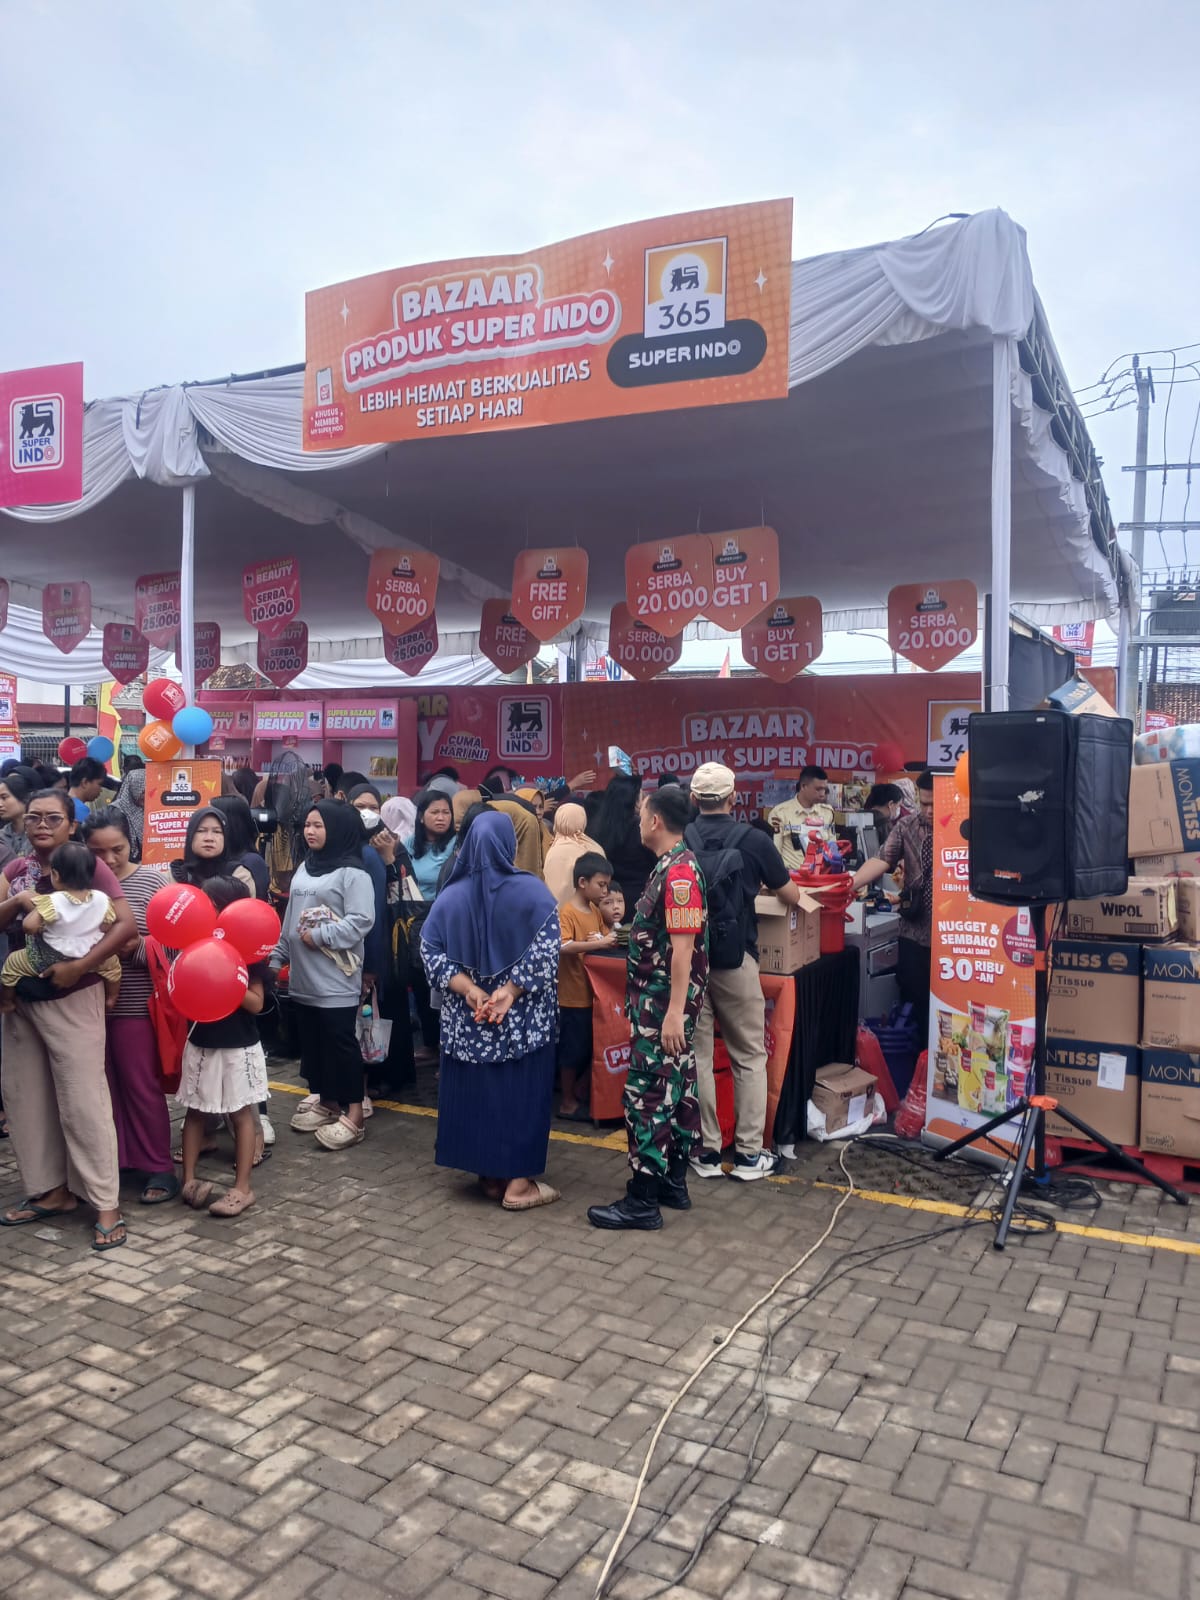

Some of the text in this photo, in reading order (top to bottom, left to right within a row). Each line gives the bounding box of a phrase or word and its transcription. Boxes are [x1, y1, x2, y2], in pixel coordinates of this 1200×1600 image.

[402, 272, 534, 322] BAZAAR
[658, 300, 710, 330] 365
[350, 299, 610, 375] PRODUK SUPER INDO
[628, 339, 742, 369] SUPER INDO
[359, 360, 591, 413] LEBIH HEMAT BERKUALITAS
[416, 397, 524, 428] SETIAP HARI
[314, 417, 339, 428] MEMBER
[22, 437, 51, 448] SUPER
[19, 445, 55, 464] INDO
[256, 566, 293, 584] BEAUTY
[648, 572, 693, 591] SERBA
[716, 566, 748, 583] BUY
[385, 579, 420, 595] SERBA
[529, 582, 568, 602] FREE
[713, 581, 768, 607] GET 1
[257, 588, 286, 604] SERBA
[637, 587, 708, 615] 20.000
[148, 601, 174, 615] SERBA
[252, 599, 294, 623] 10.000
[375, 593, 428, 616] 10.000
[531, 605, 562, 621] GIFT
[910, 613, 957, 629] SERBA
[142, 612, 180, 632] 25.000
[397, 632, 425, 647] SERBA
[495, 625, 526, 642] FREE
[627, 631, 666, 644] SERBA
[767, 629, 796, 643] BUY
[898, 628, 973, 651] 20.000
[270, 647, 296, 657] SERBA
[392, 641, 433, 661] 25.000
[496, 644, 521, 657] GIFT
[618, 643, 675, 663] 10.000
[751, 642, 814, 662] 1 GET 1
[263, 658, 301, 671] 10.000
[256, 718, 305, 731] BEAUTY
[325, 716, 376, 730] BEAUTY
[690, 714, 805, 742] BAZAAR
[448, 735, 482, 748] CUMA
[510, 732, 539, 740] SUPER
[440, 746, 466, 757] HARI
[506, 739, 543, 753] INDO
[637, 747, 874, 776] PRODUK SUPER INDO
[174, 783, 189, 792] 365
[1175, 767, 1200, 841] MONTISS
[150, 811, 179, 821] BAZAAR
[159, 820, 182, 830] SUPER
[941, 883, 962, 892] LEBIH
[1100, 902, 1143, 918] WIPOL
[938, 921, 1000, 936] NUGGET &
[1073, 915, 1079, 927] 8
[941, 934, 998, 949] SEMBAKO
[953, 947, 990, 956] MULAI DARI
[938, 957, 1005, 982] 30 RIBU
[975, 972, 995, 983] -AN
[1056, 975, 1095, 988] Tissue
[1054, 1072, 1092, 1087] Tissue
